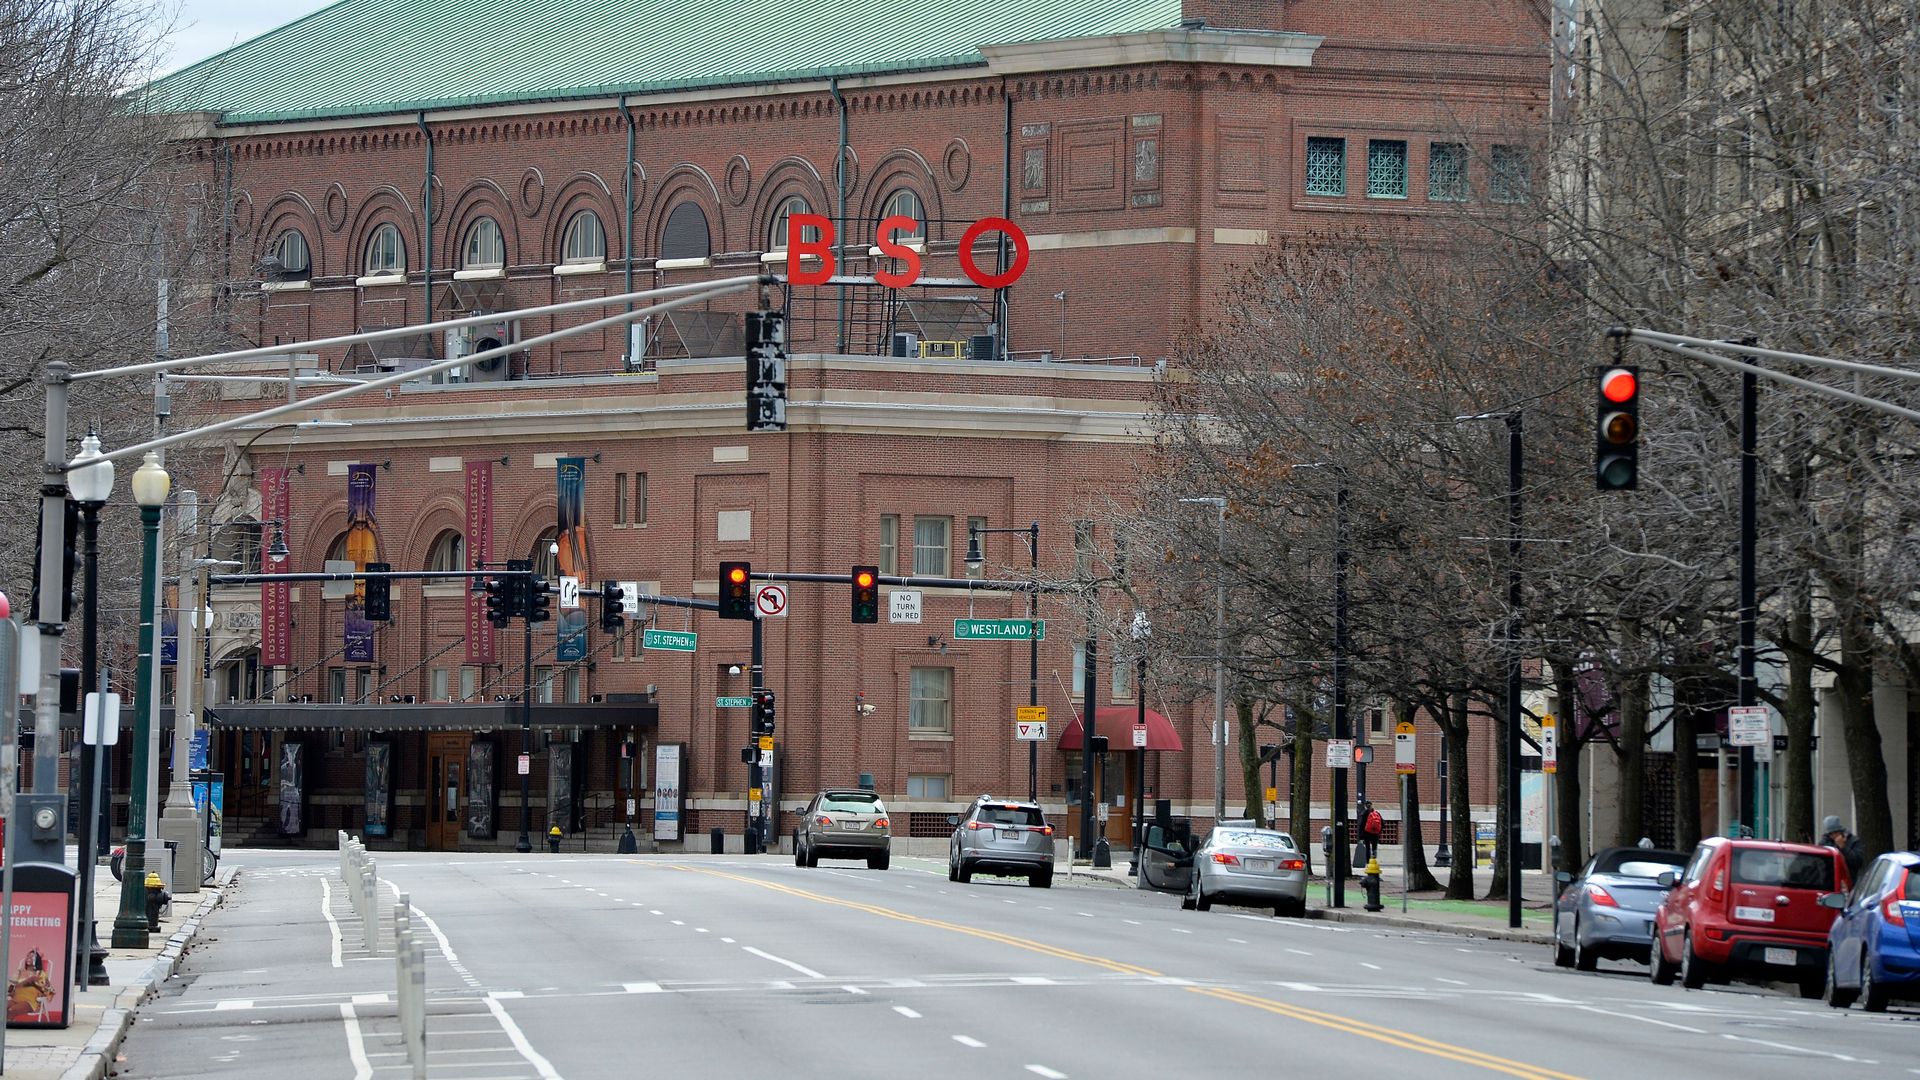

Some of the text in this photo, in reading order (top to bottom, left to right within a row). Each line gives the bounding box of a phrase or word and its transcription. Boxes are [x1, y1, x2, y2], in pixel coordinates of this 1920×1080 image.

[899, 594, 912, 602] NO
[896, 603, 915, 611] TURN
[471, 612, 479, 658] BOSTON
[971, 624, 1027, 636] WESTLAND
[268, 615, 276, 660] BOSTON
[653, 634, 662, 645] ST.
[663, 635, 689, 647] STEPHEN
